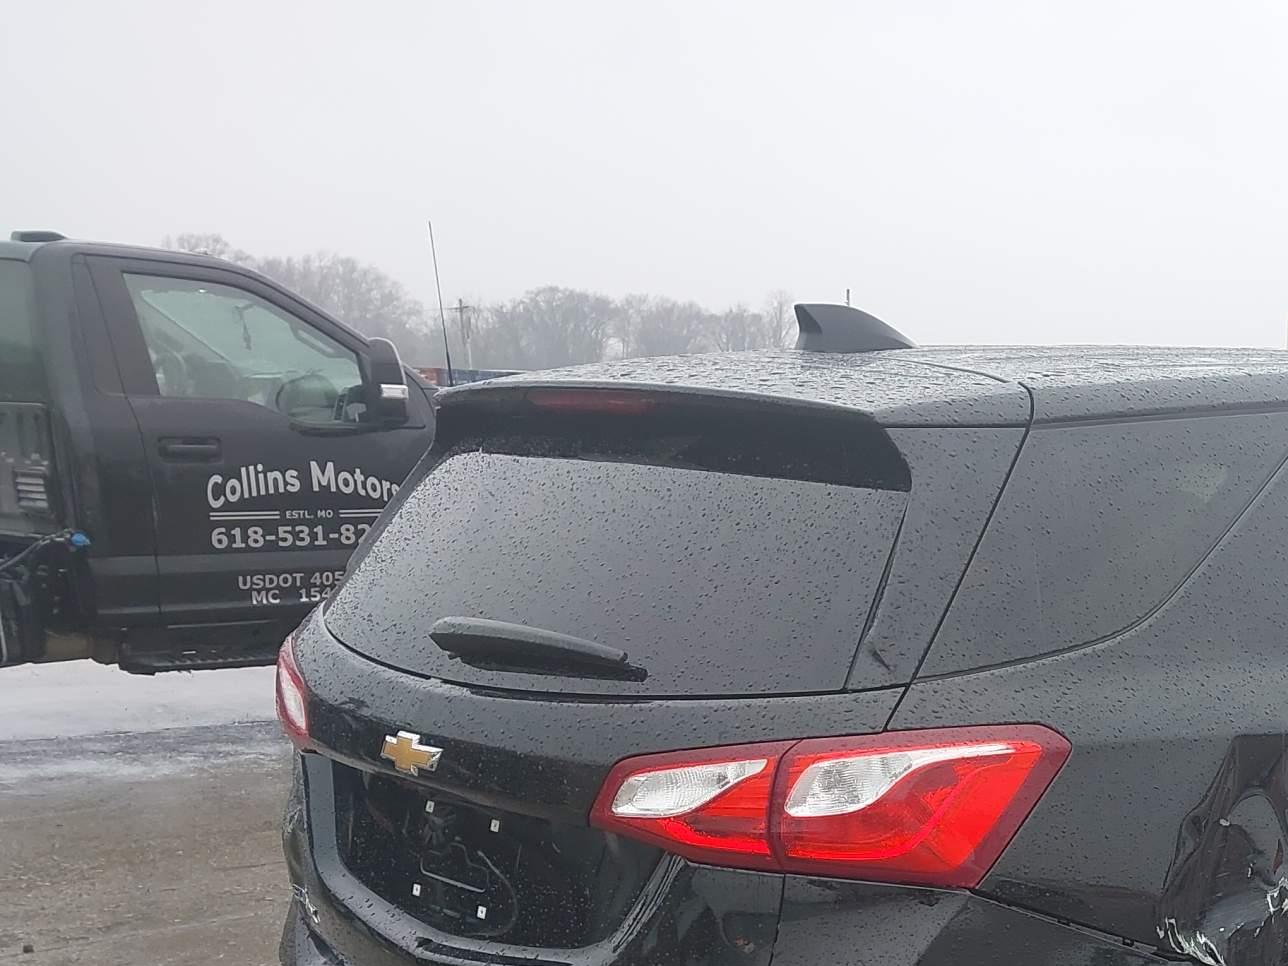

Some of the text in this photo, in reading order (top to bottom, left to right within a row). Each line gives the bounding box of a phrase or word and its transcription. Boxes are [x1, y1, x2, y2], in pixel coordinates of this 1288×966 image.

[207, 463, 301, 508] Collins
[238, 573, 305, 590] USDOT
[252, 589, 281, 605] MC
